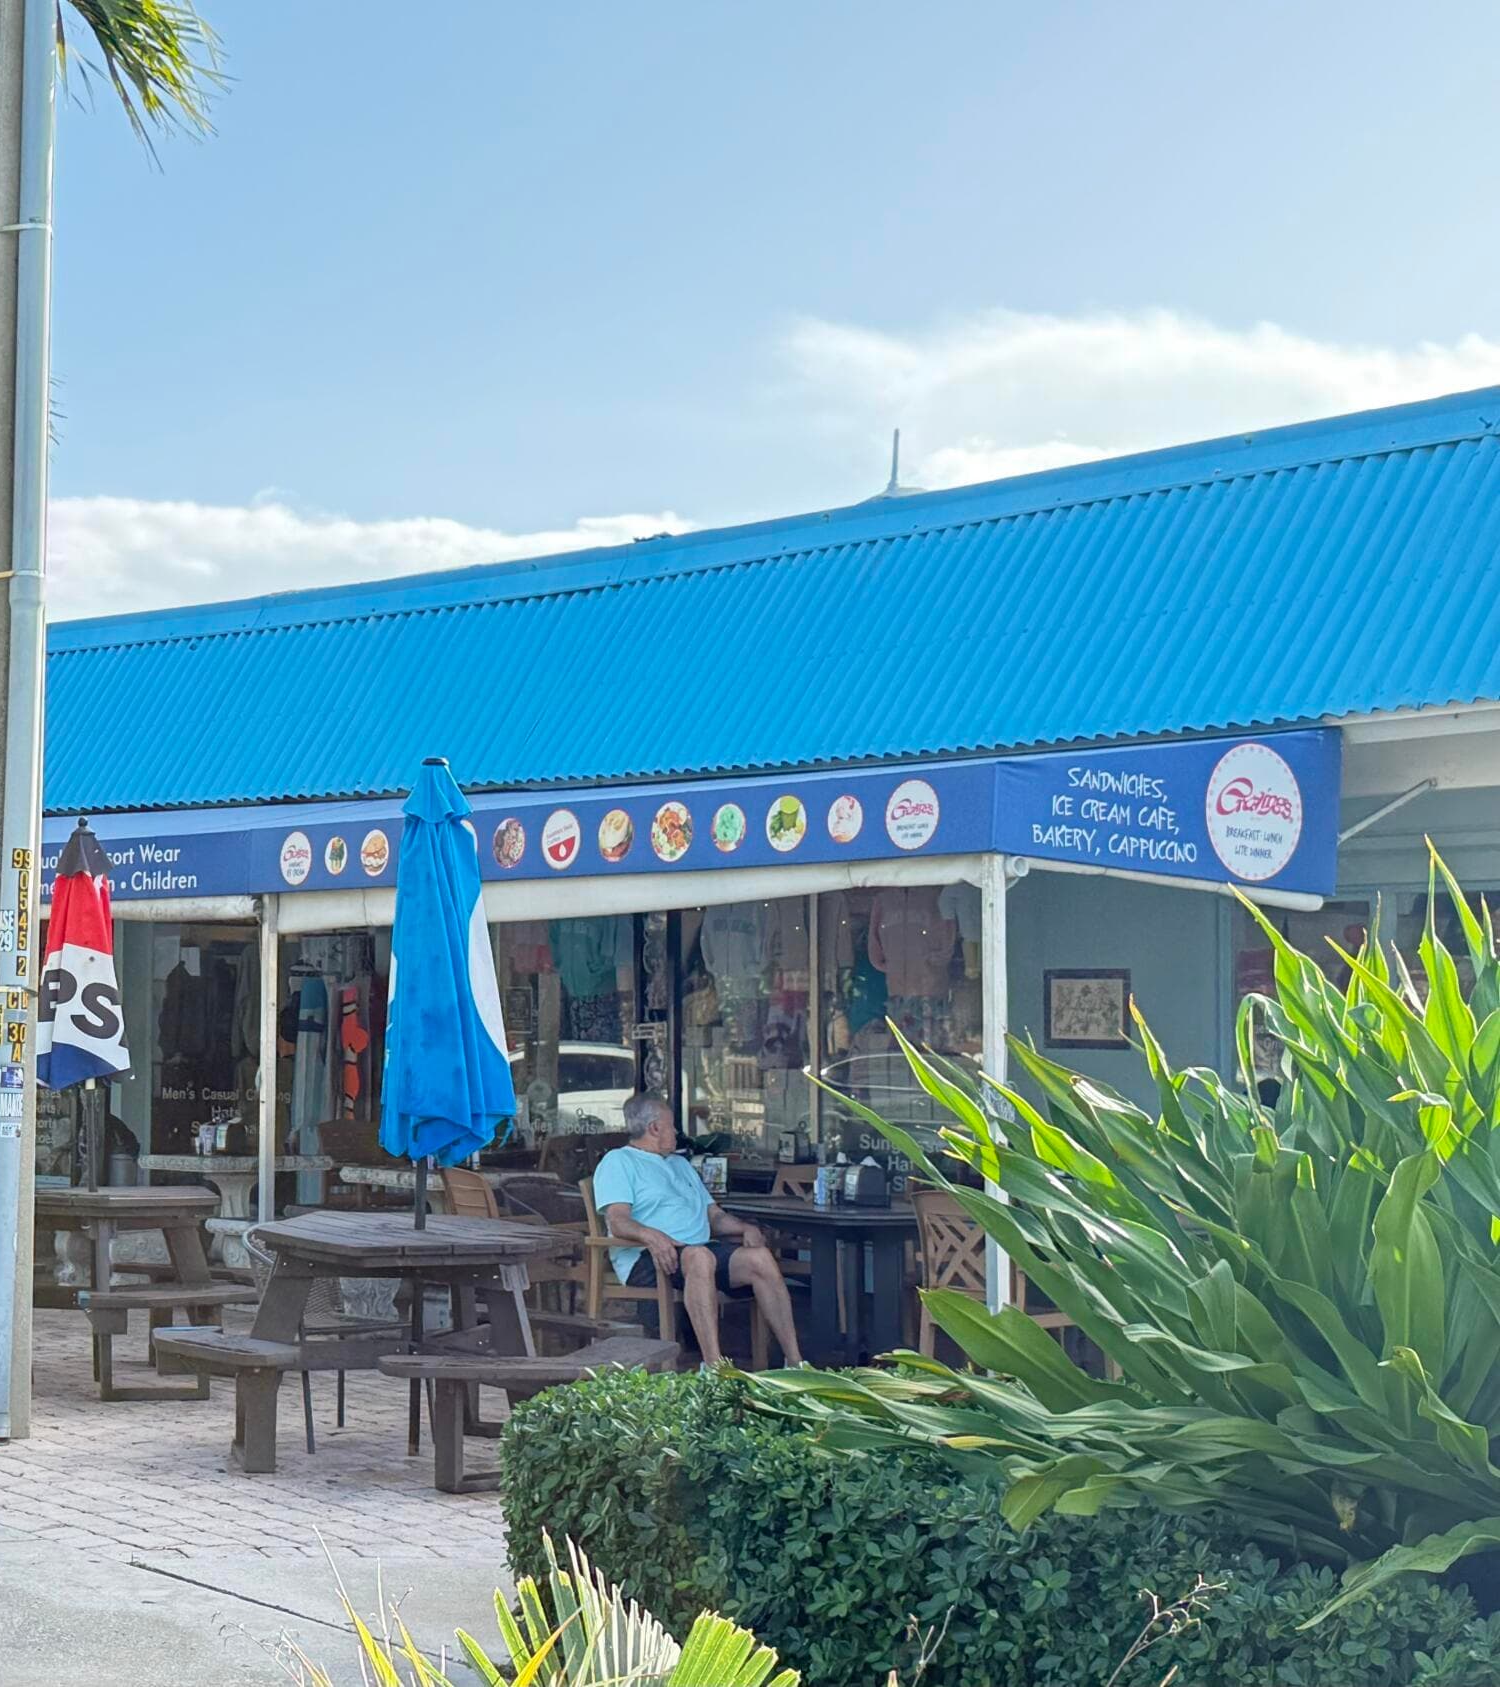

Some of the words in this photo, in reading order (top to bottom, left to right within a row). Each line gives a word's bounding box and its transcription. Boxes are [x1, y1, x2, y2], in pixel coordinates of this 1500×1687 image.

[1068, 767, 1167, 803] SANDWICHES,
[1052, 795, 1073, 816] ICE
[1081, 799, 1130, 826] CREAM
[1138, 806, 1179, 836] CAFE,
[139, 843, 181, 864] Wear
[1032, 824, 1100, 856] BAKERY,
[1108, 833, 1197, 863] CAPPUCCINO
[131, 871, 197, 892] Children
[162, 1087, 196, 1100] Men's
[201, 1087, 240, 1101] Casual
